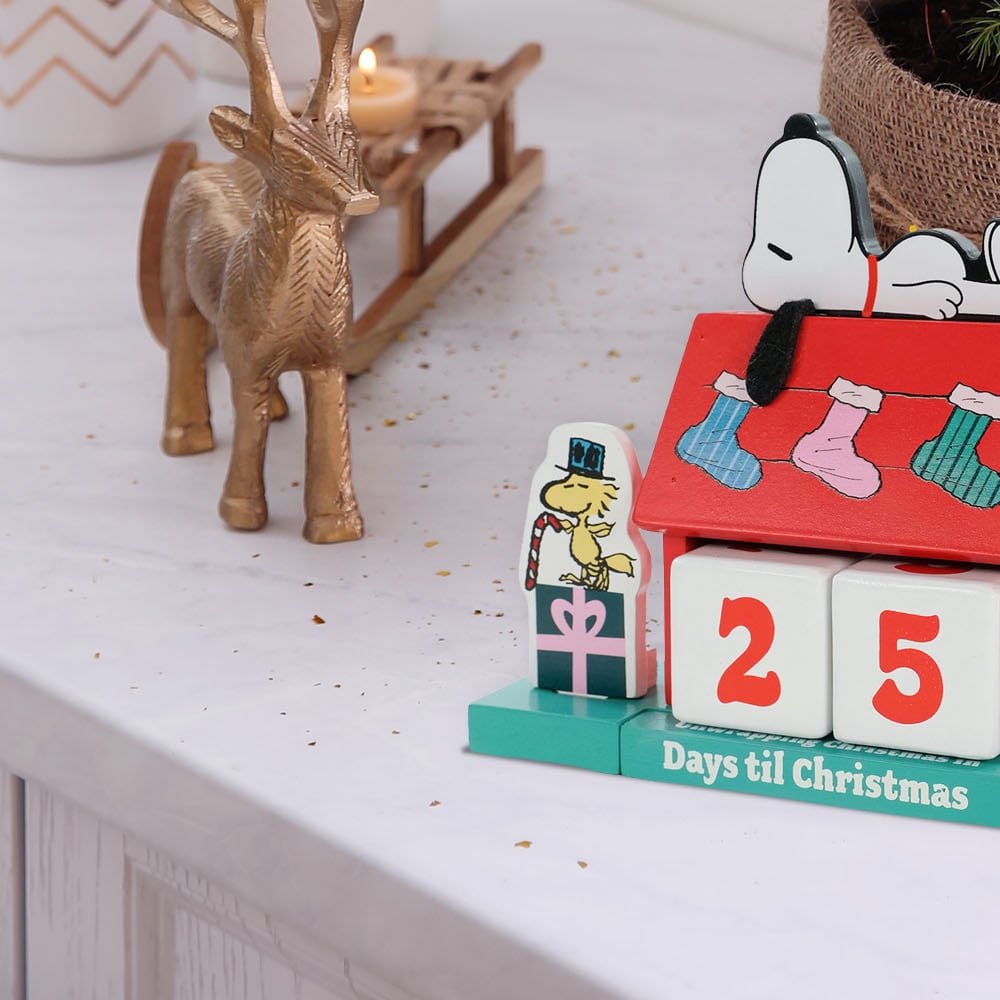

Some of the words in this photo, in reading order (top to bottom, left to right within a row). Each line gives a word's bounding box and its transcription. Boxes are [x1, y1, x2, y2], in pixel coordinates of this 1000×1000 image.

[716, 596, 782, 707] 2
[871, 609, 944, 725] 5
[662, 740, 738, 785] Days
[745, 749, 785, 785] til
[792, 756, 969, 810] Christmas
